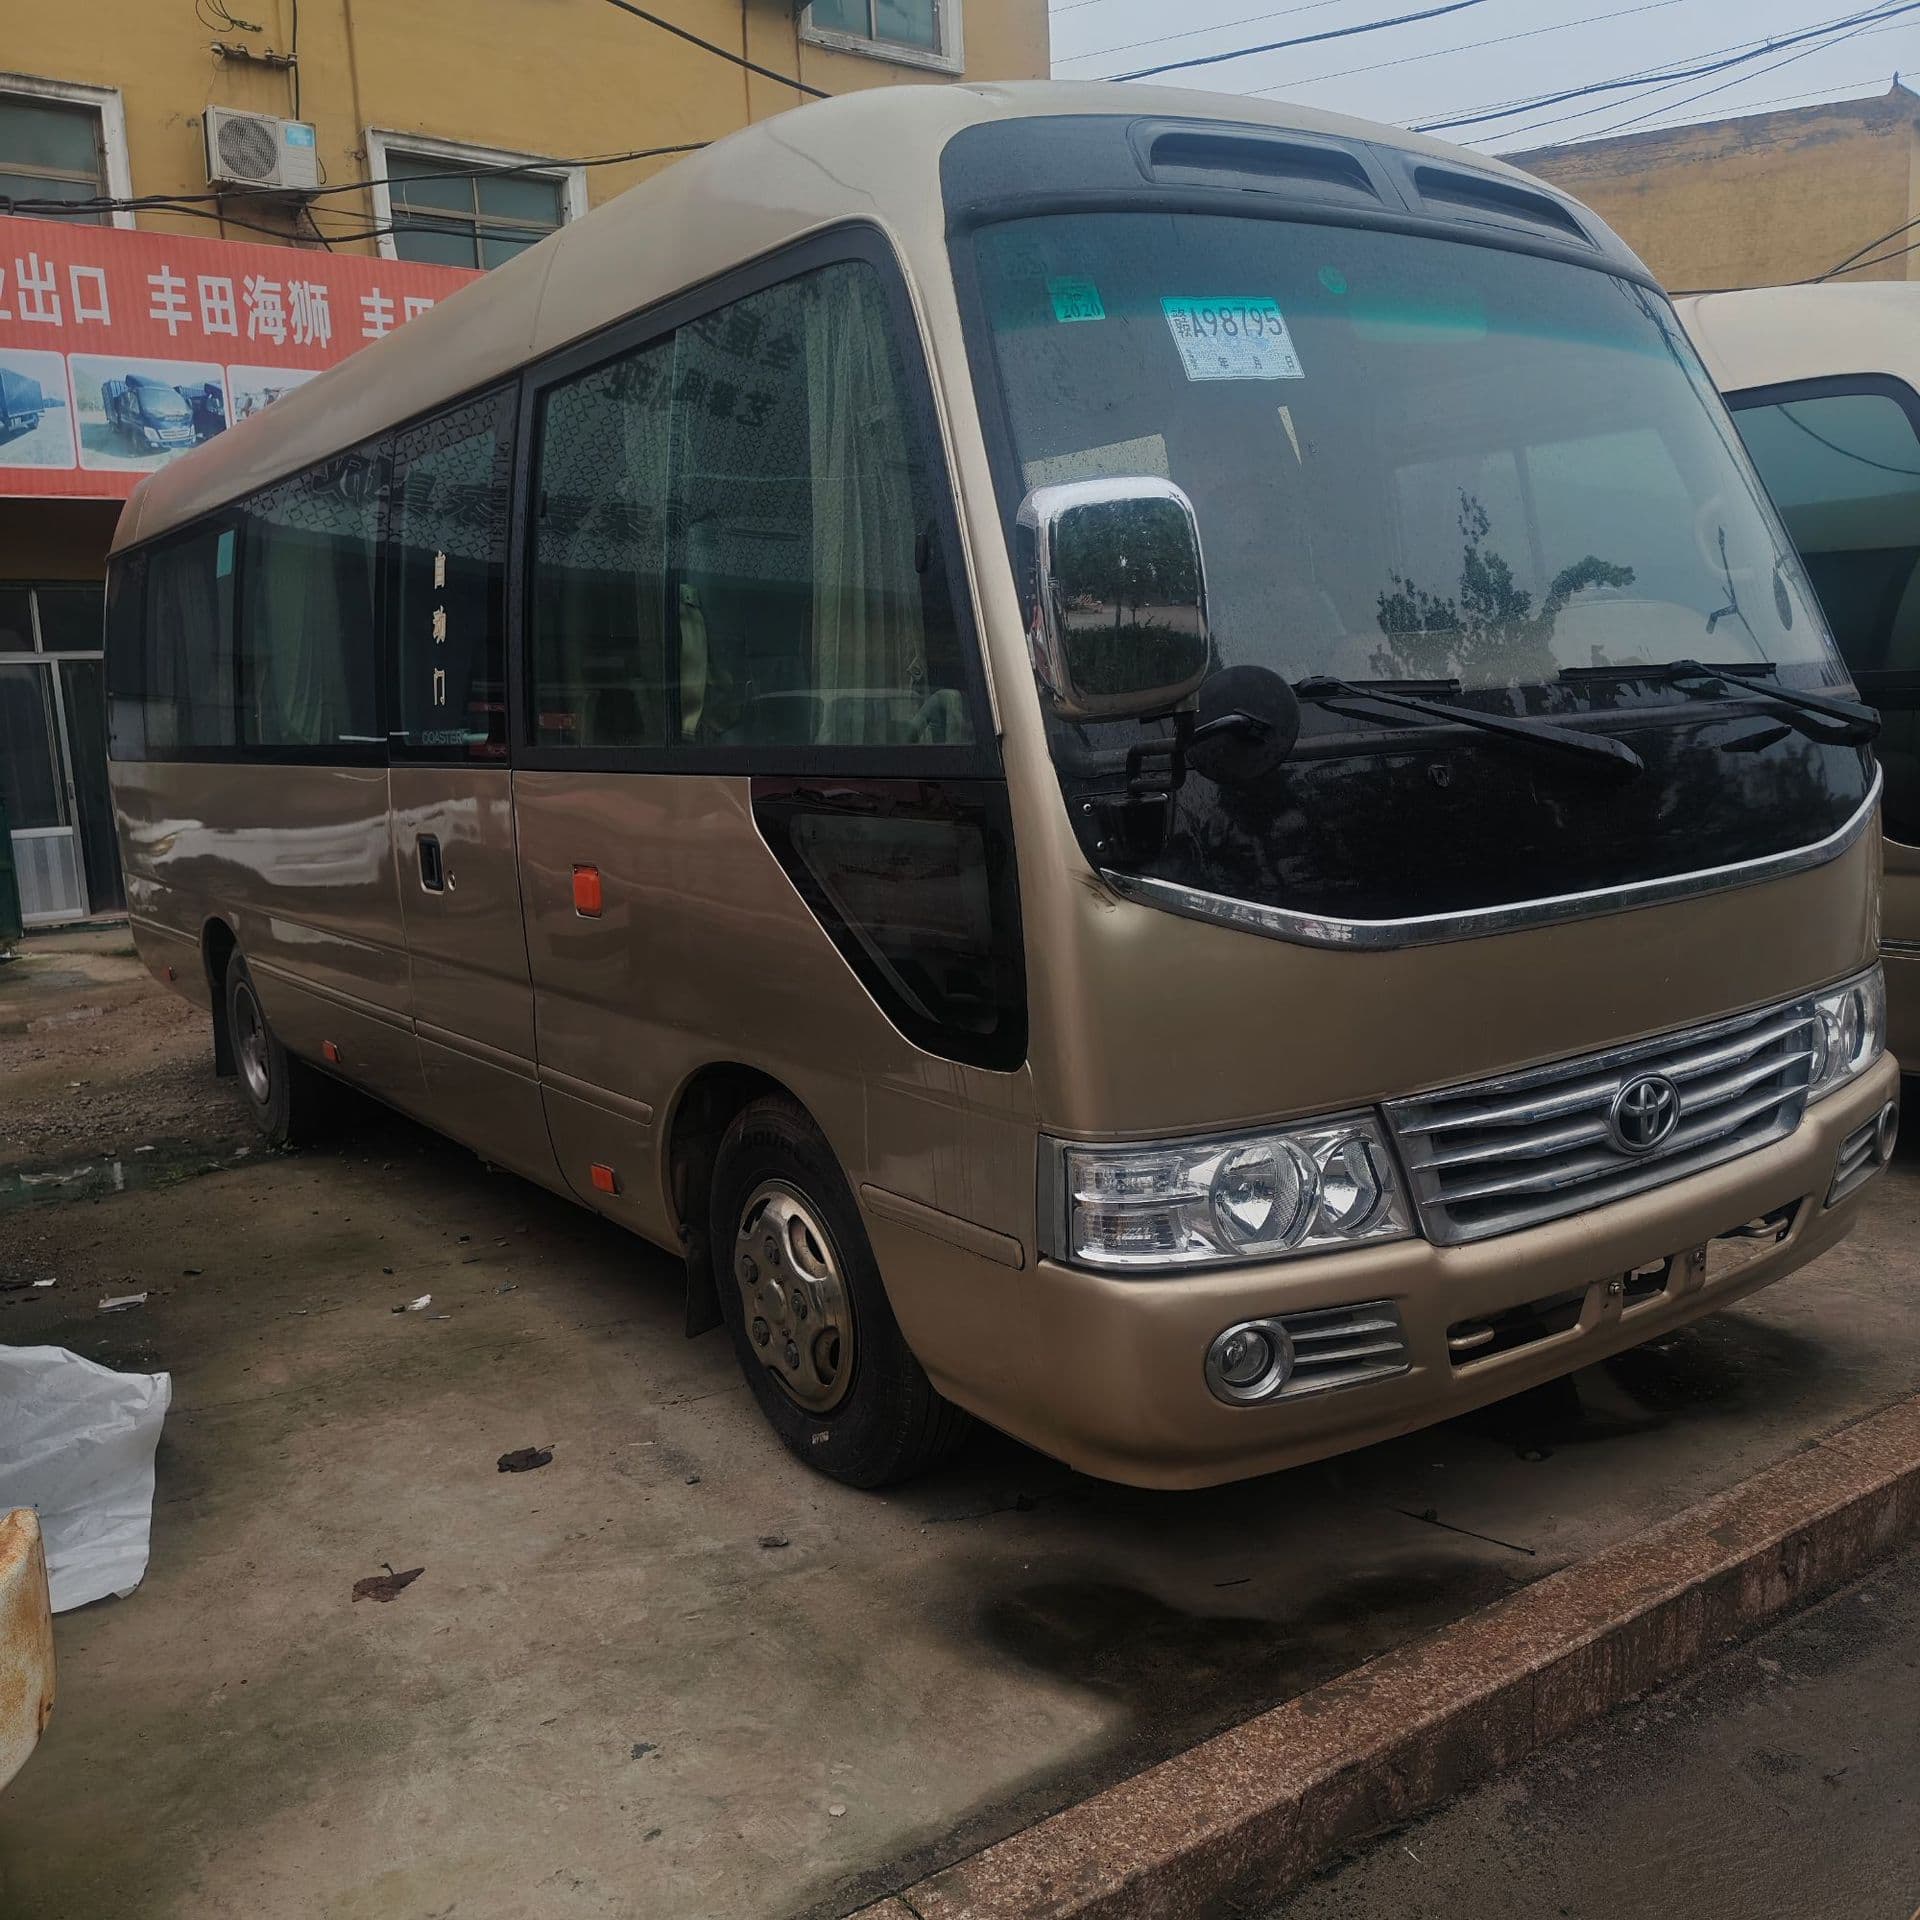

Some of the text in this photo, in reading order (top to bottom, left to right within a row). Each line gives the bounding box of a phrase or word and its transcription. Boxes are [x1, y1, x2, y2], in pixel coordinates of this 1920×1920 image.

[147, 264, 333, 349] 丰田海狮
[422, 730, 463, 744] COASTER
